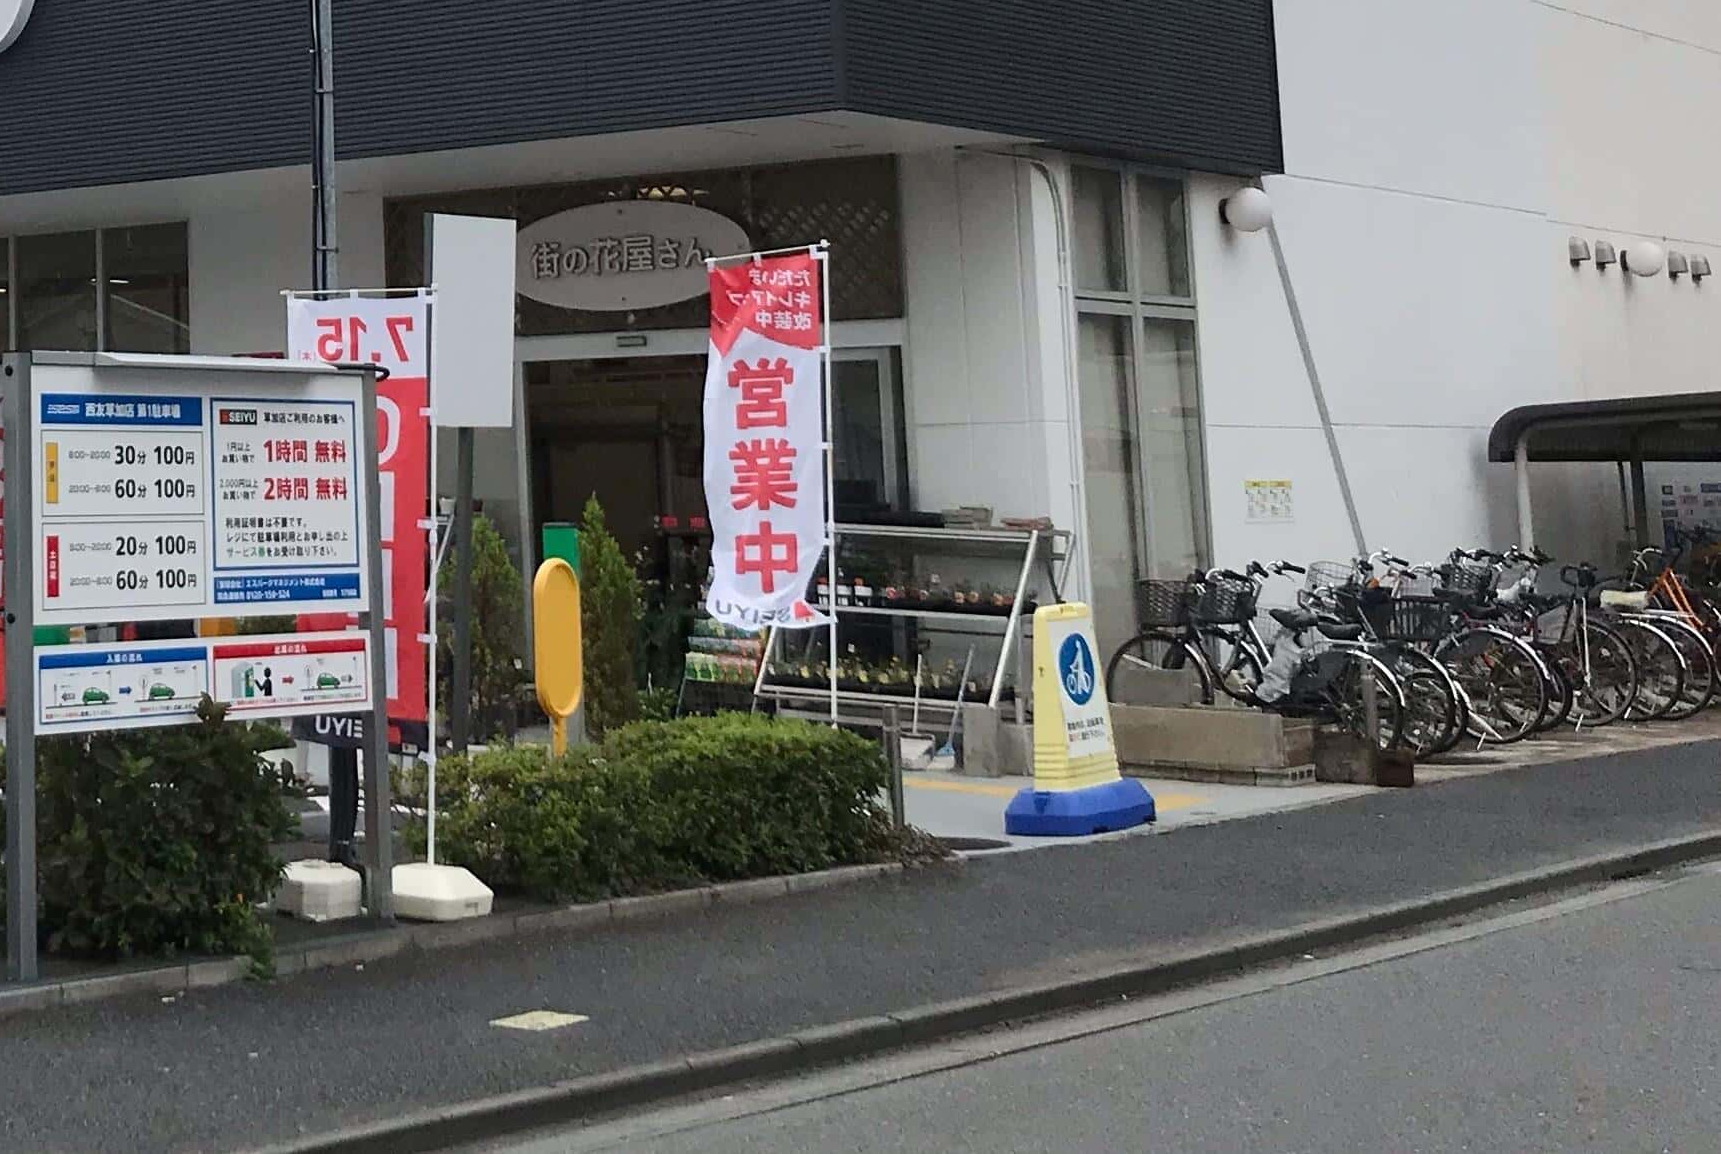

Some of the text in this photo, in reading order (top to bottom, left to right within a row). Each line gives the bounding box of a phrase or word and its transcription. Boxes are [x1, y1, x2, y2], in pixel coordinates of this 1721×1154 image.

[530, 235, 712, 279] 街の花屋さん
[229, 412, 256, 423] SEIYU
[114, 445, 146, 465] 30分
[153, 445, 195, 465] 100円
[263, 440, 347, 463] 1時間 無料
[115, 479, 147, 498] 60分
[154, 479, 195, 498] 100円
[264, 478, 347, 501] 2時間 無料
[115, 536, 148, 556] 20分
[156, 535, 196, 555] 100円
[116, 570, 149, 590] 60分
[156, 569, 197, 589] 100円
